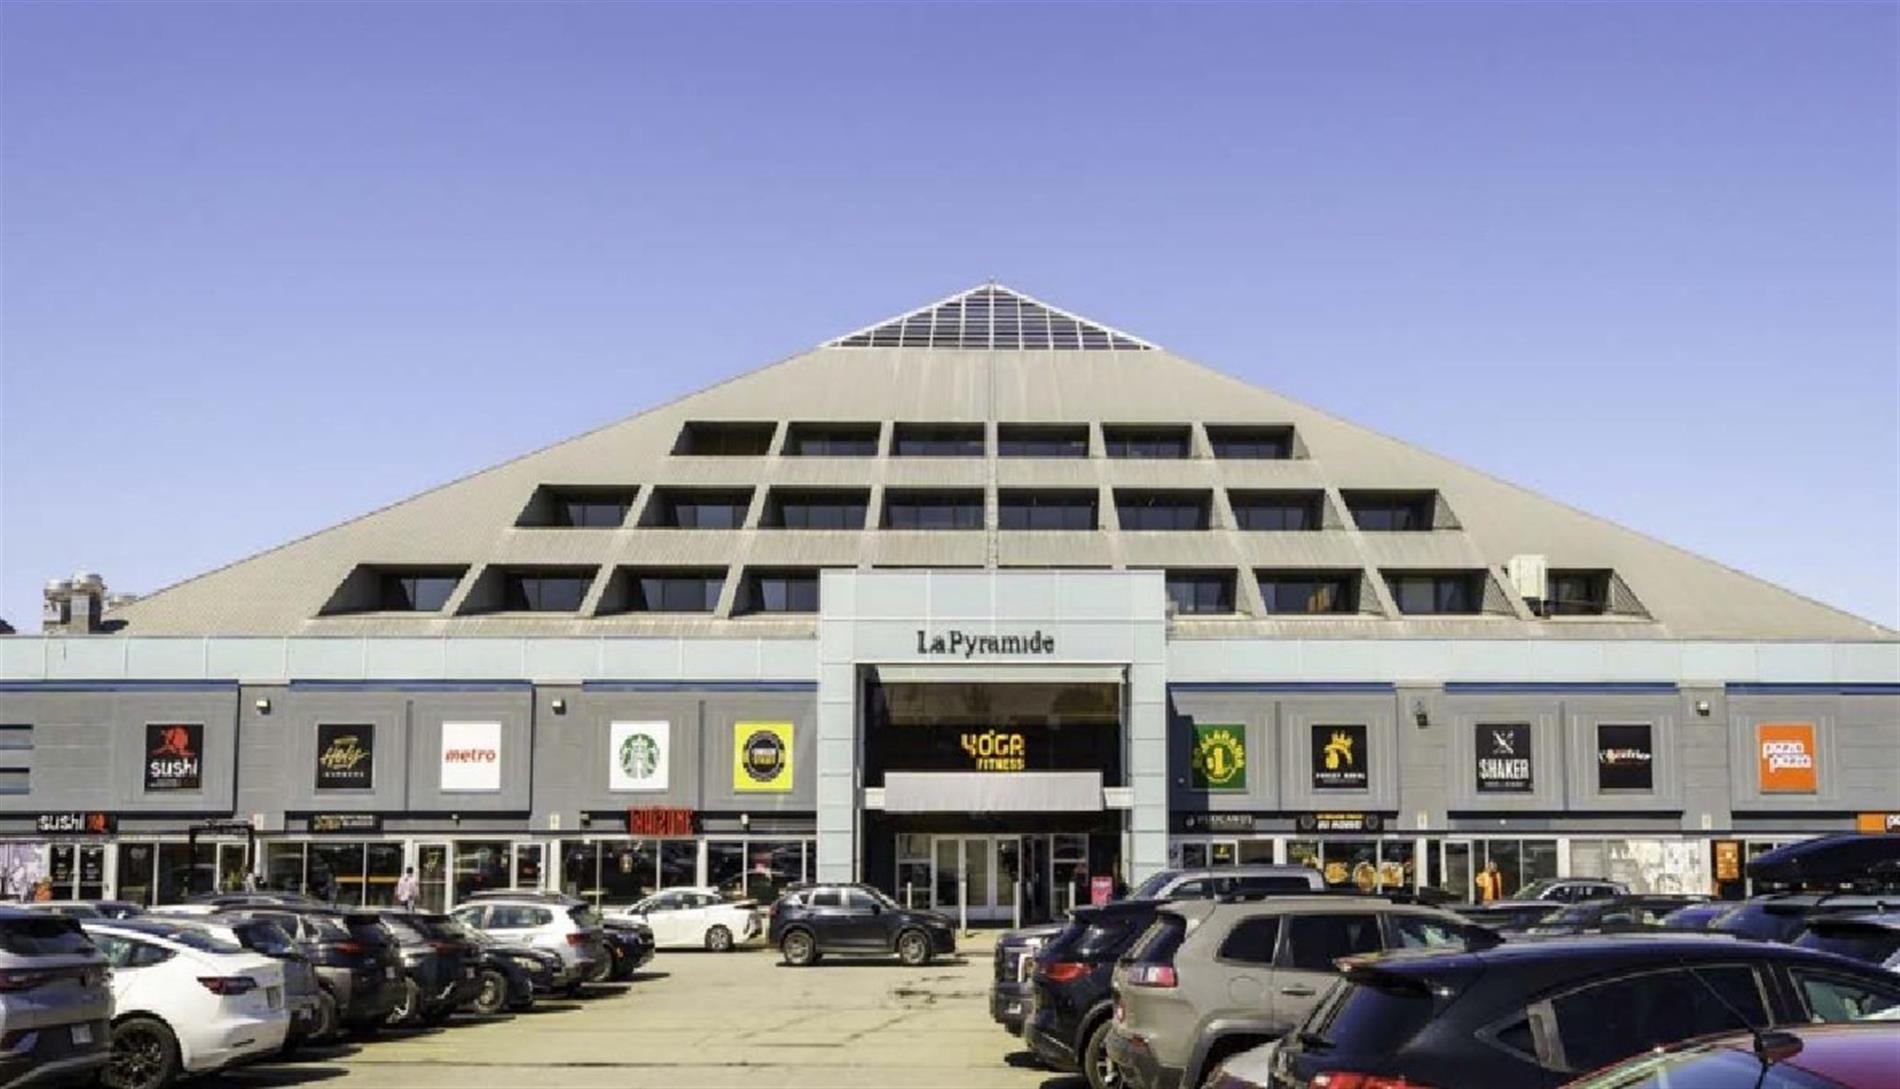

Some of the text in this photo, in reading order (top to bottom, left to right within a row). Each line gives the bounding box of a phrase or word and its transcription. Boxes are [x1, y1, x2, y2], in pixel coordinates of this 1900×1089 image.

[917, 630, 1054, 659] La Pyramide
[960, 729, 1025, 757] YOGA
[446, 749, 496, 763] metro
[977, 758, 1025, 770] FITNESS
[150, 758, 198, 777] sushi
[1479, 759, 1529, 779] SHAKER
